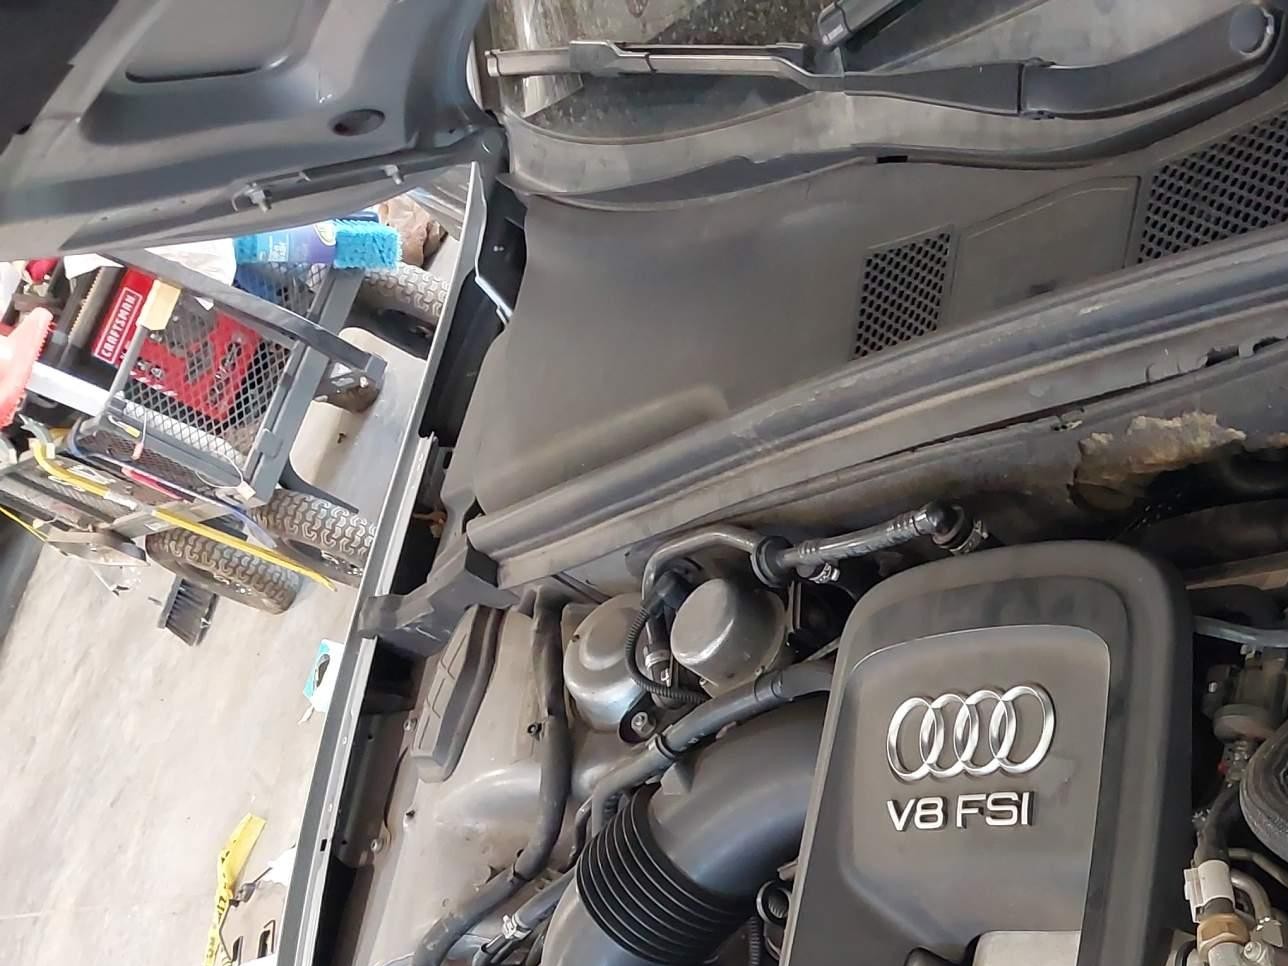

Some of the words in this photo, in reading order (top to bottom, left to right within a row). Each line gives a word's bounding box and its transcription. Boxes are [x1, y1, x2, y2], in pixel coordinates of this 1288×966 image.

[100, 294, 136, 358] CRAFTSMAN
[886, 796, 945, 831] V8
[956, 791, 1032, 828] FSI
